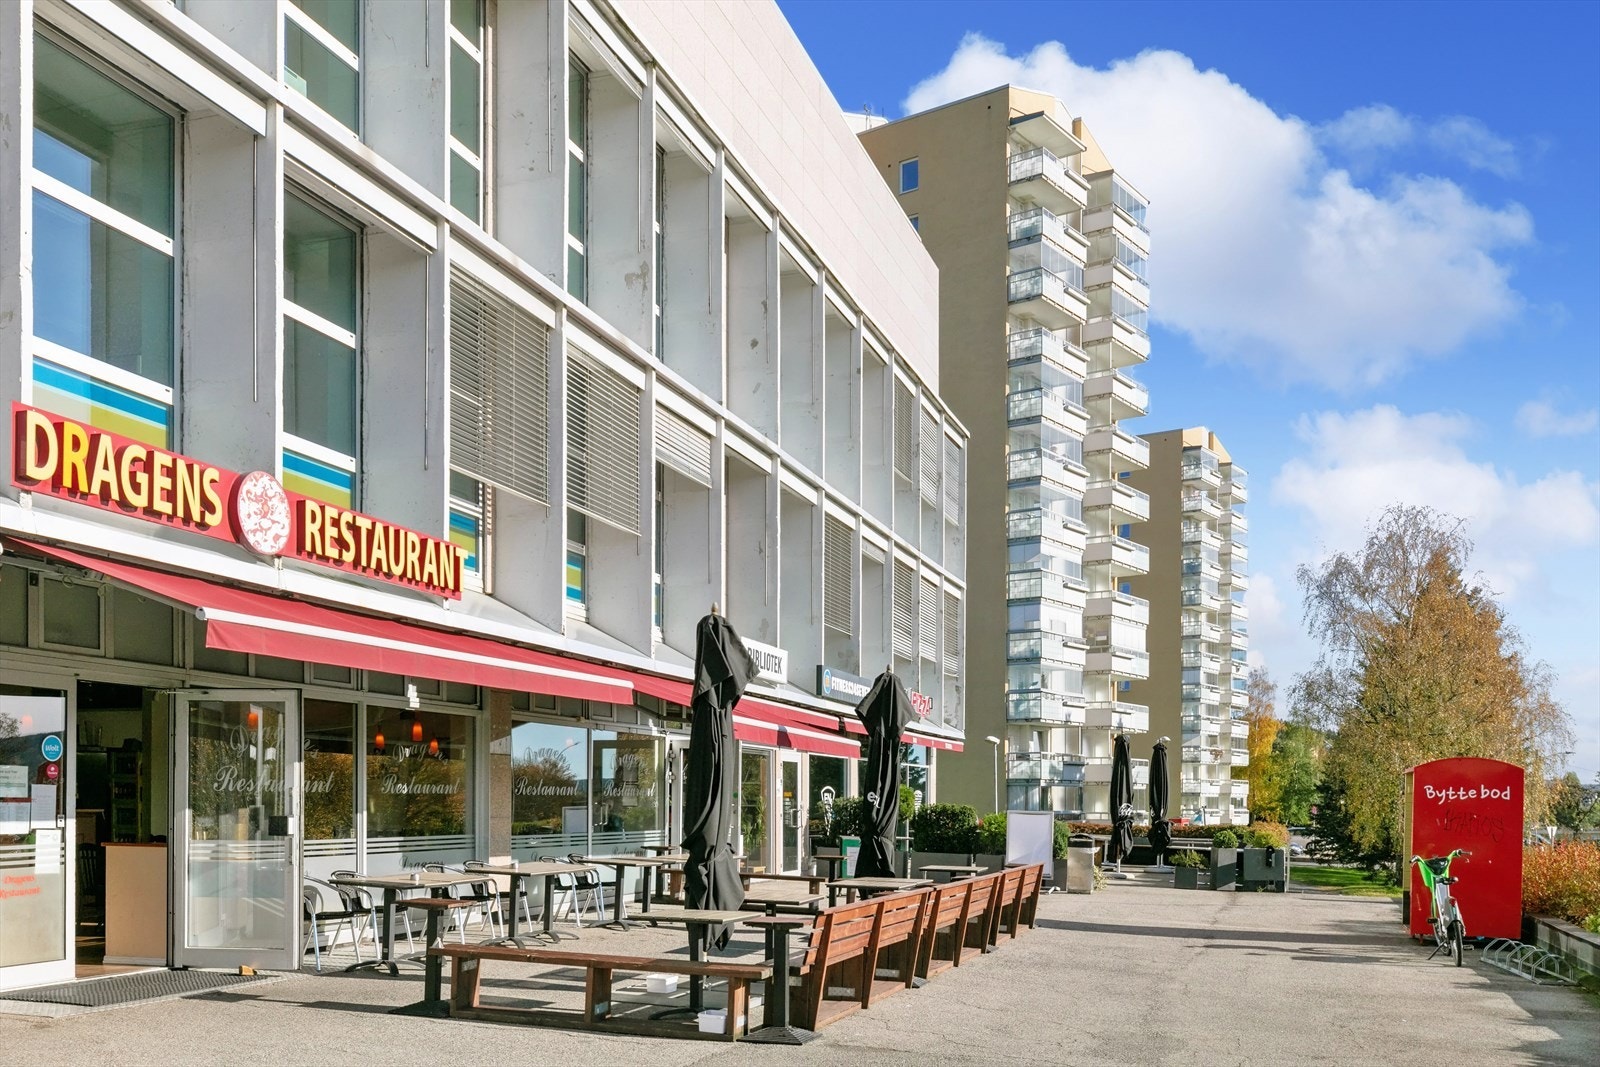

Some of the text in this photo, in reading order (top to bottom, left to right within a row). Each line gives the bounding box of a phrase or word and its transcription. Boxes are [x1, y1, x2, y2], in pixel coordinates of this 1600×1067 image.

[24, 409, 469, 593] DRAGENS RESTAURANT
[45, 744, 59, 752] Wolt
[213, 765, 335, 794] Restauant
[381, 773, 461, 795] Restaurant
[515, 776, 580, 796] Restaurant
[604, 782, 656, 797] Restaurant
[1480, 784, 1511, 800] bod
